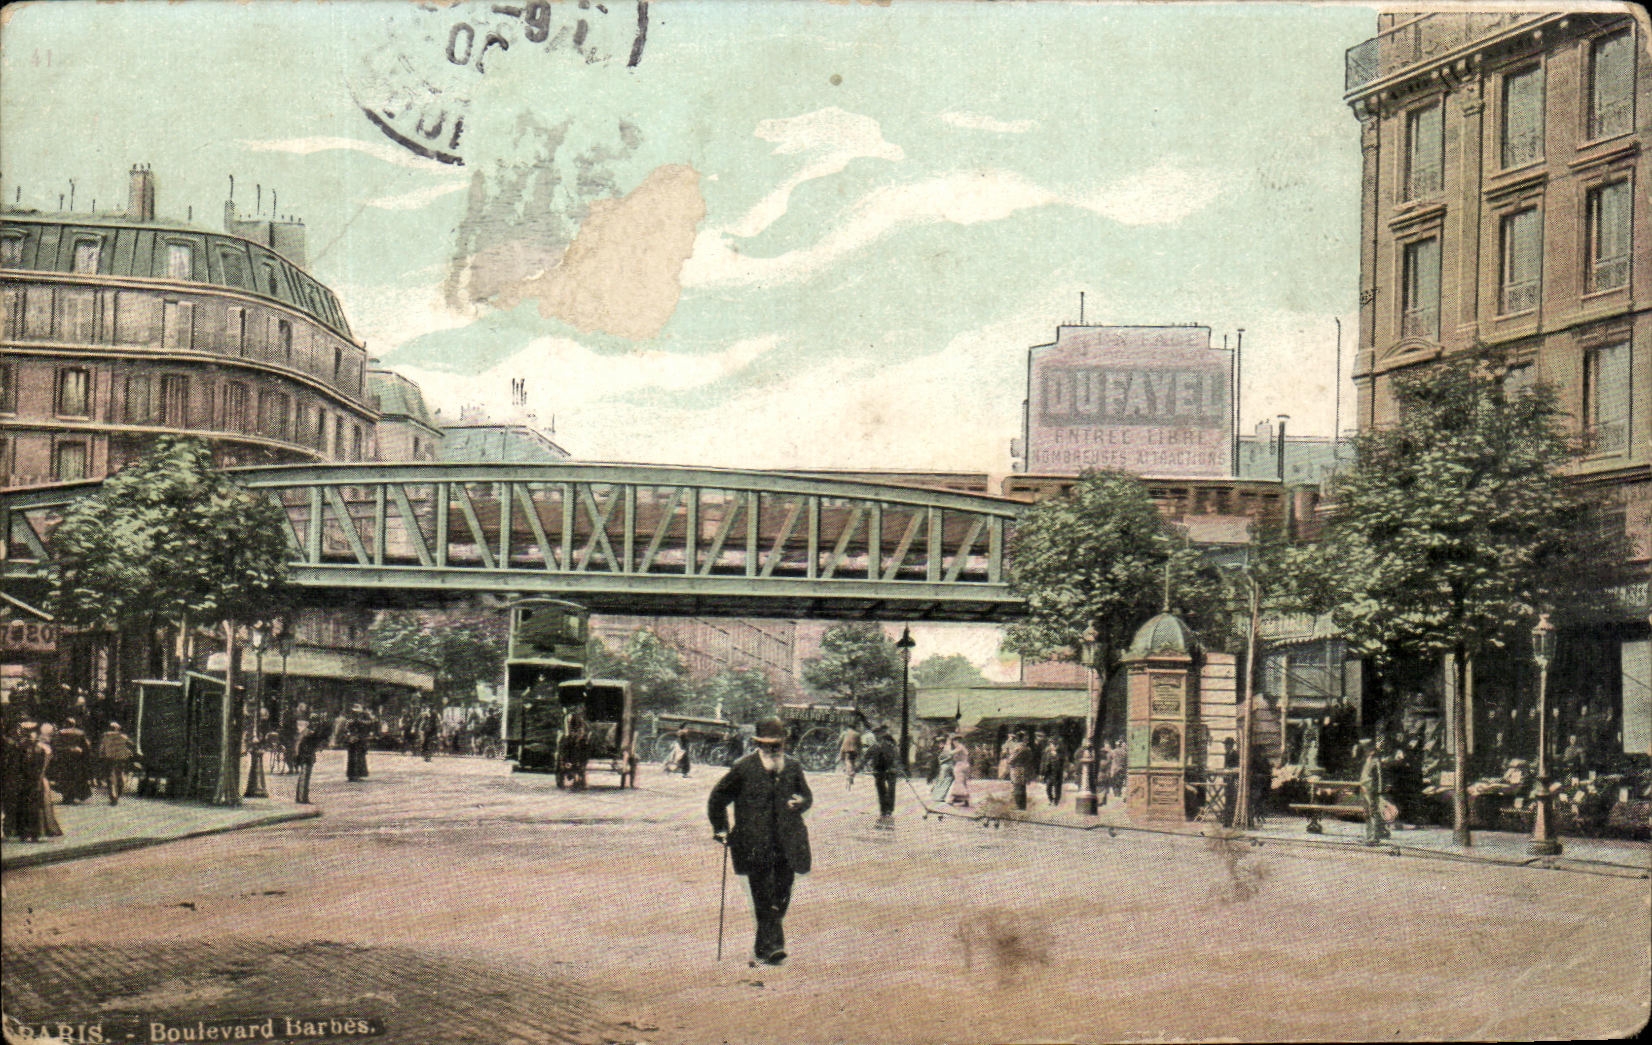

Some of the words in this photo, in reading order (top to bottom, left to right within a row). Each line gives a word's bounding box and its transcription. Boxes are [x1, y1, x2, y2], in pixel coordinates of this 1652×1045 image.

[1046, 368, 1221, 418] DUFAYEL
[1147, 429, 1206, 445] LIBRE
[1033, 450, 1127, 465] NOMBREUSES
[1137, 450, 1226, 466] ATTRACTIONS
